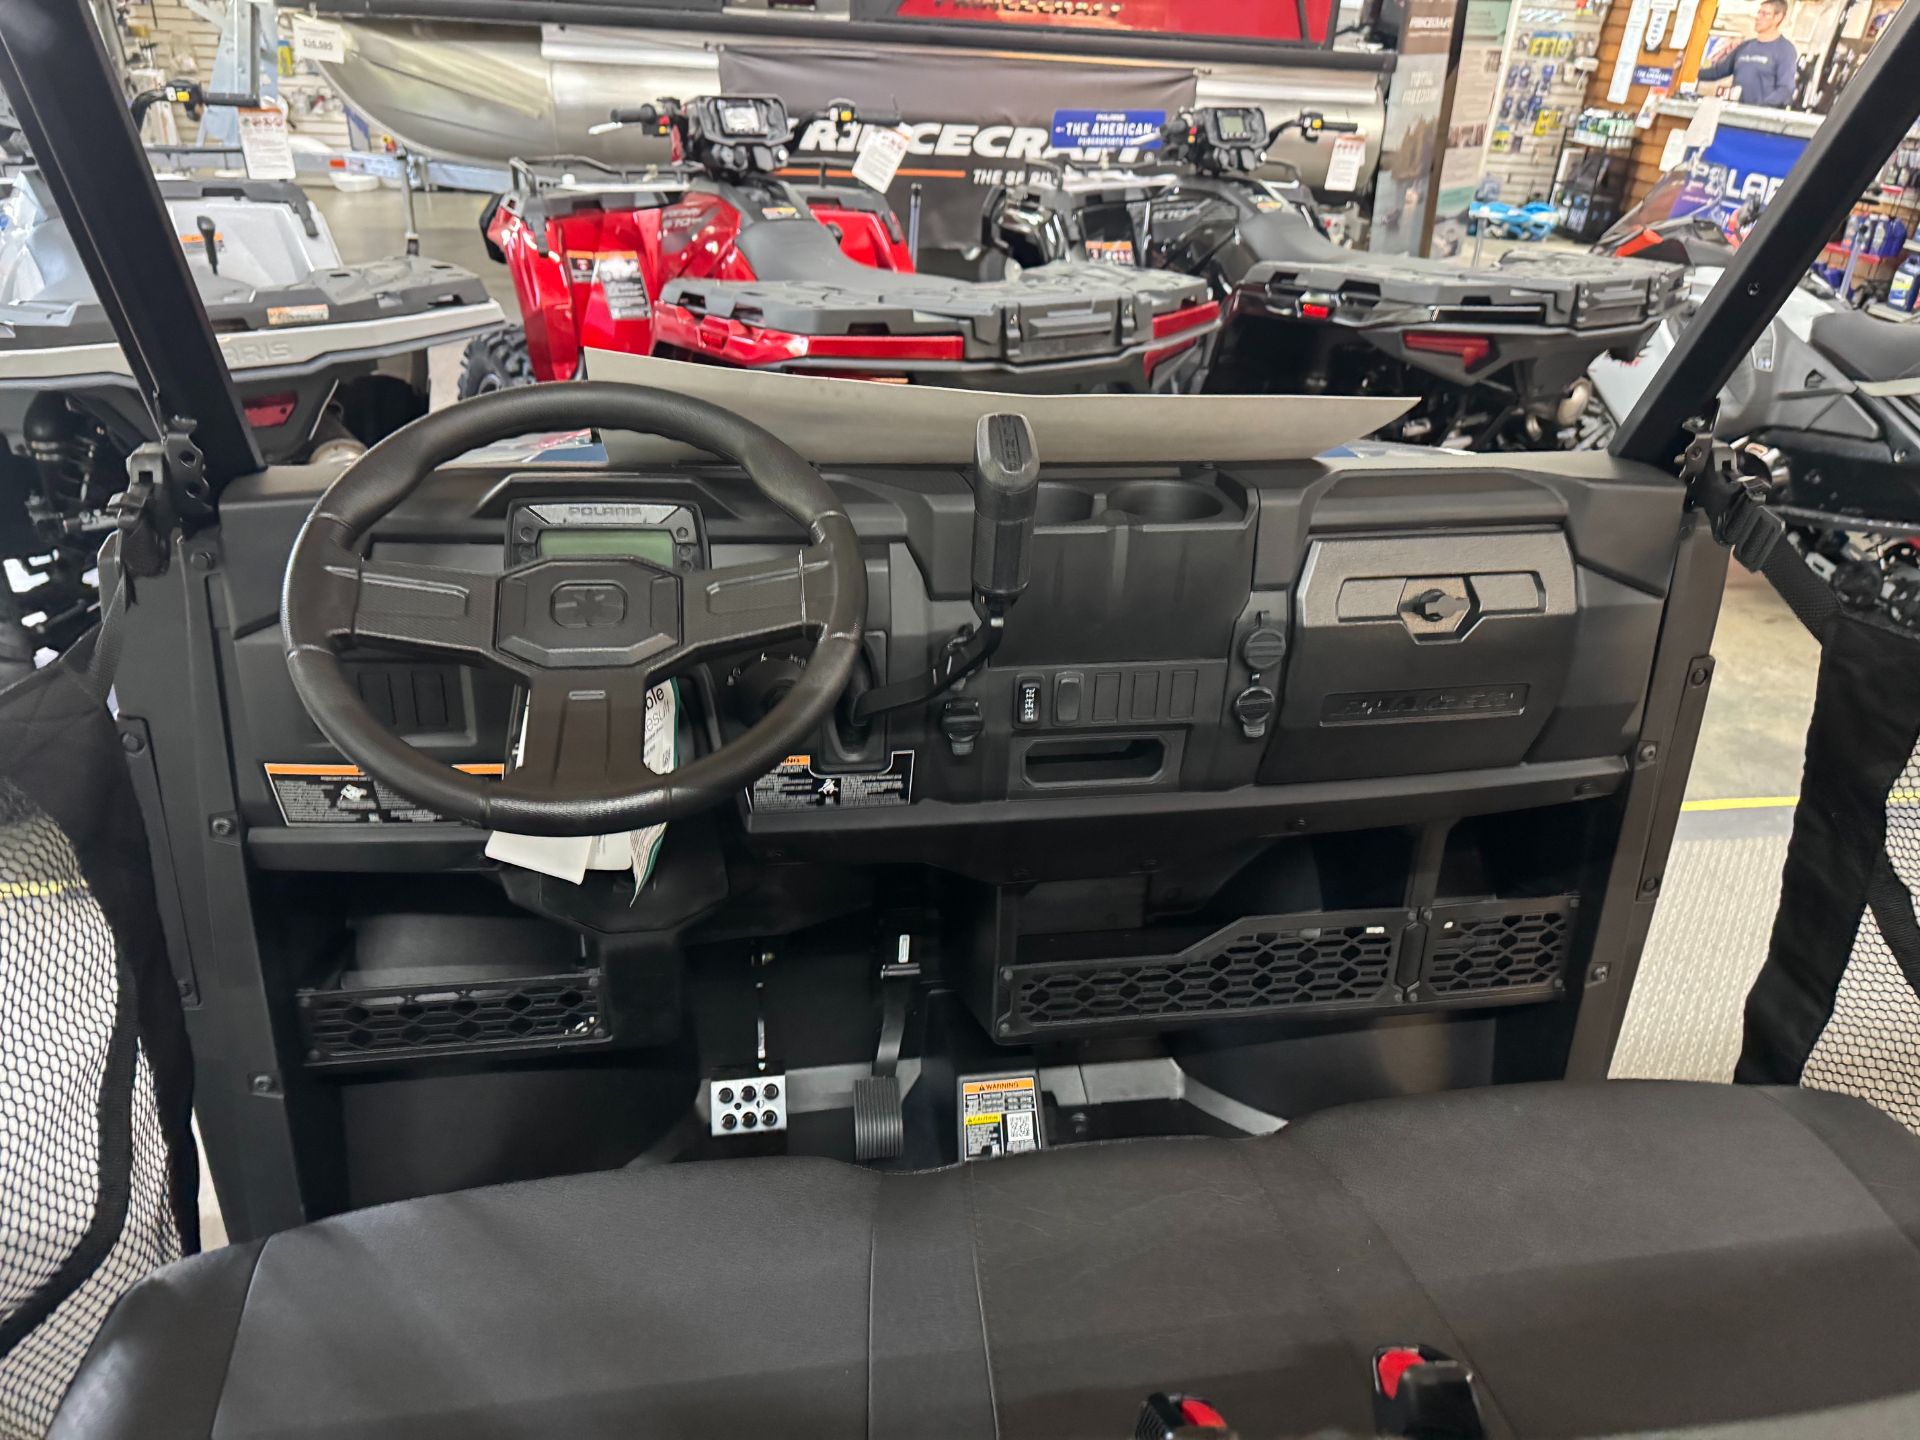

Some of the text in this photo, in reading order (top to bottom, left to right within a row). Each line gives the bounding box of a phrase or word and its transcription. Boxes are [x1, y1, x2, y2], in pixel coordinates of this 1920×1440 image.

[1066, 122, 1153, 137] THE AMERICAN
[974, 169, 1003, 185] THE
[568, 507, 642, 516] POLARIS
[986, 1081, 1019, 1091] WARNING
